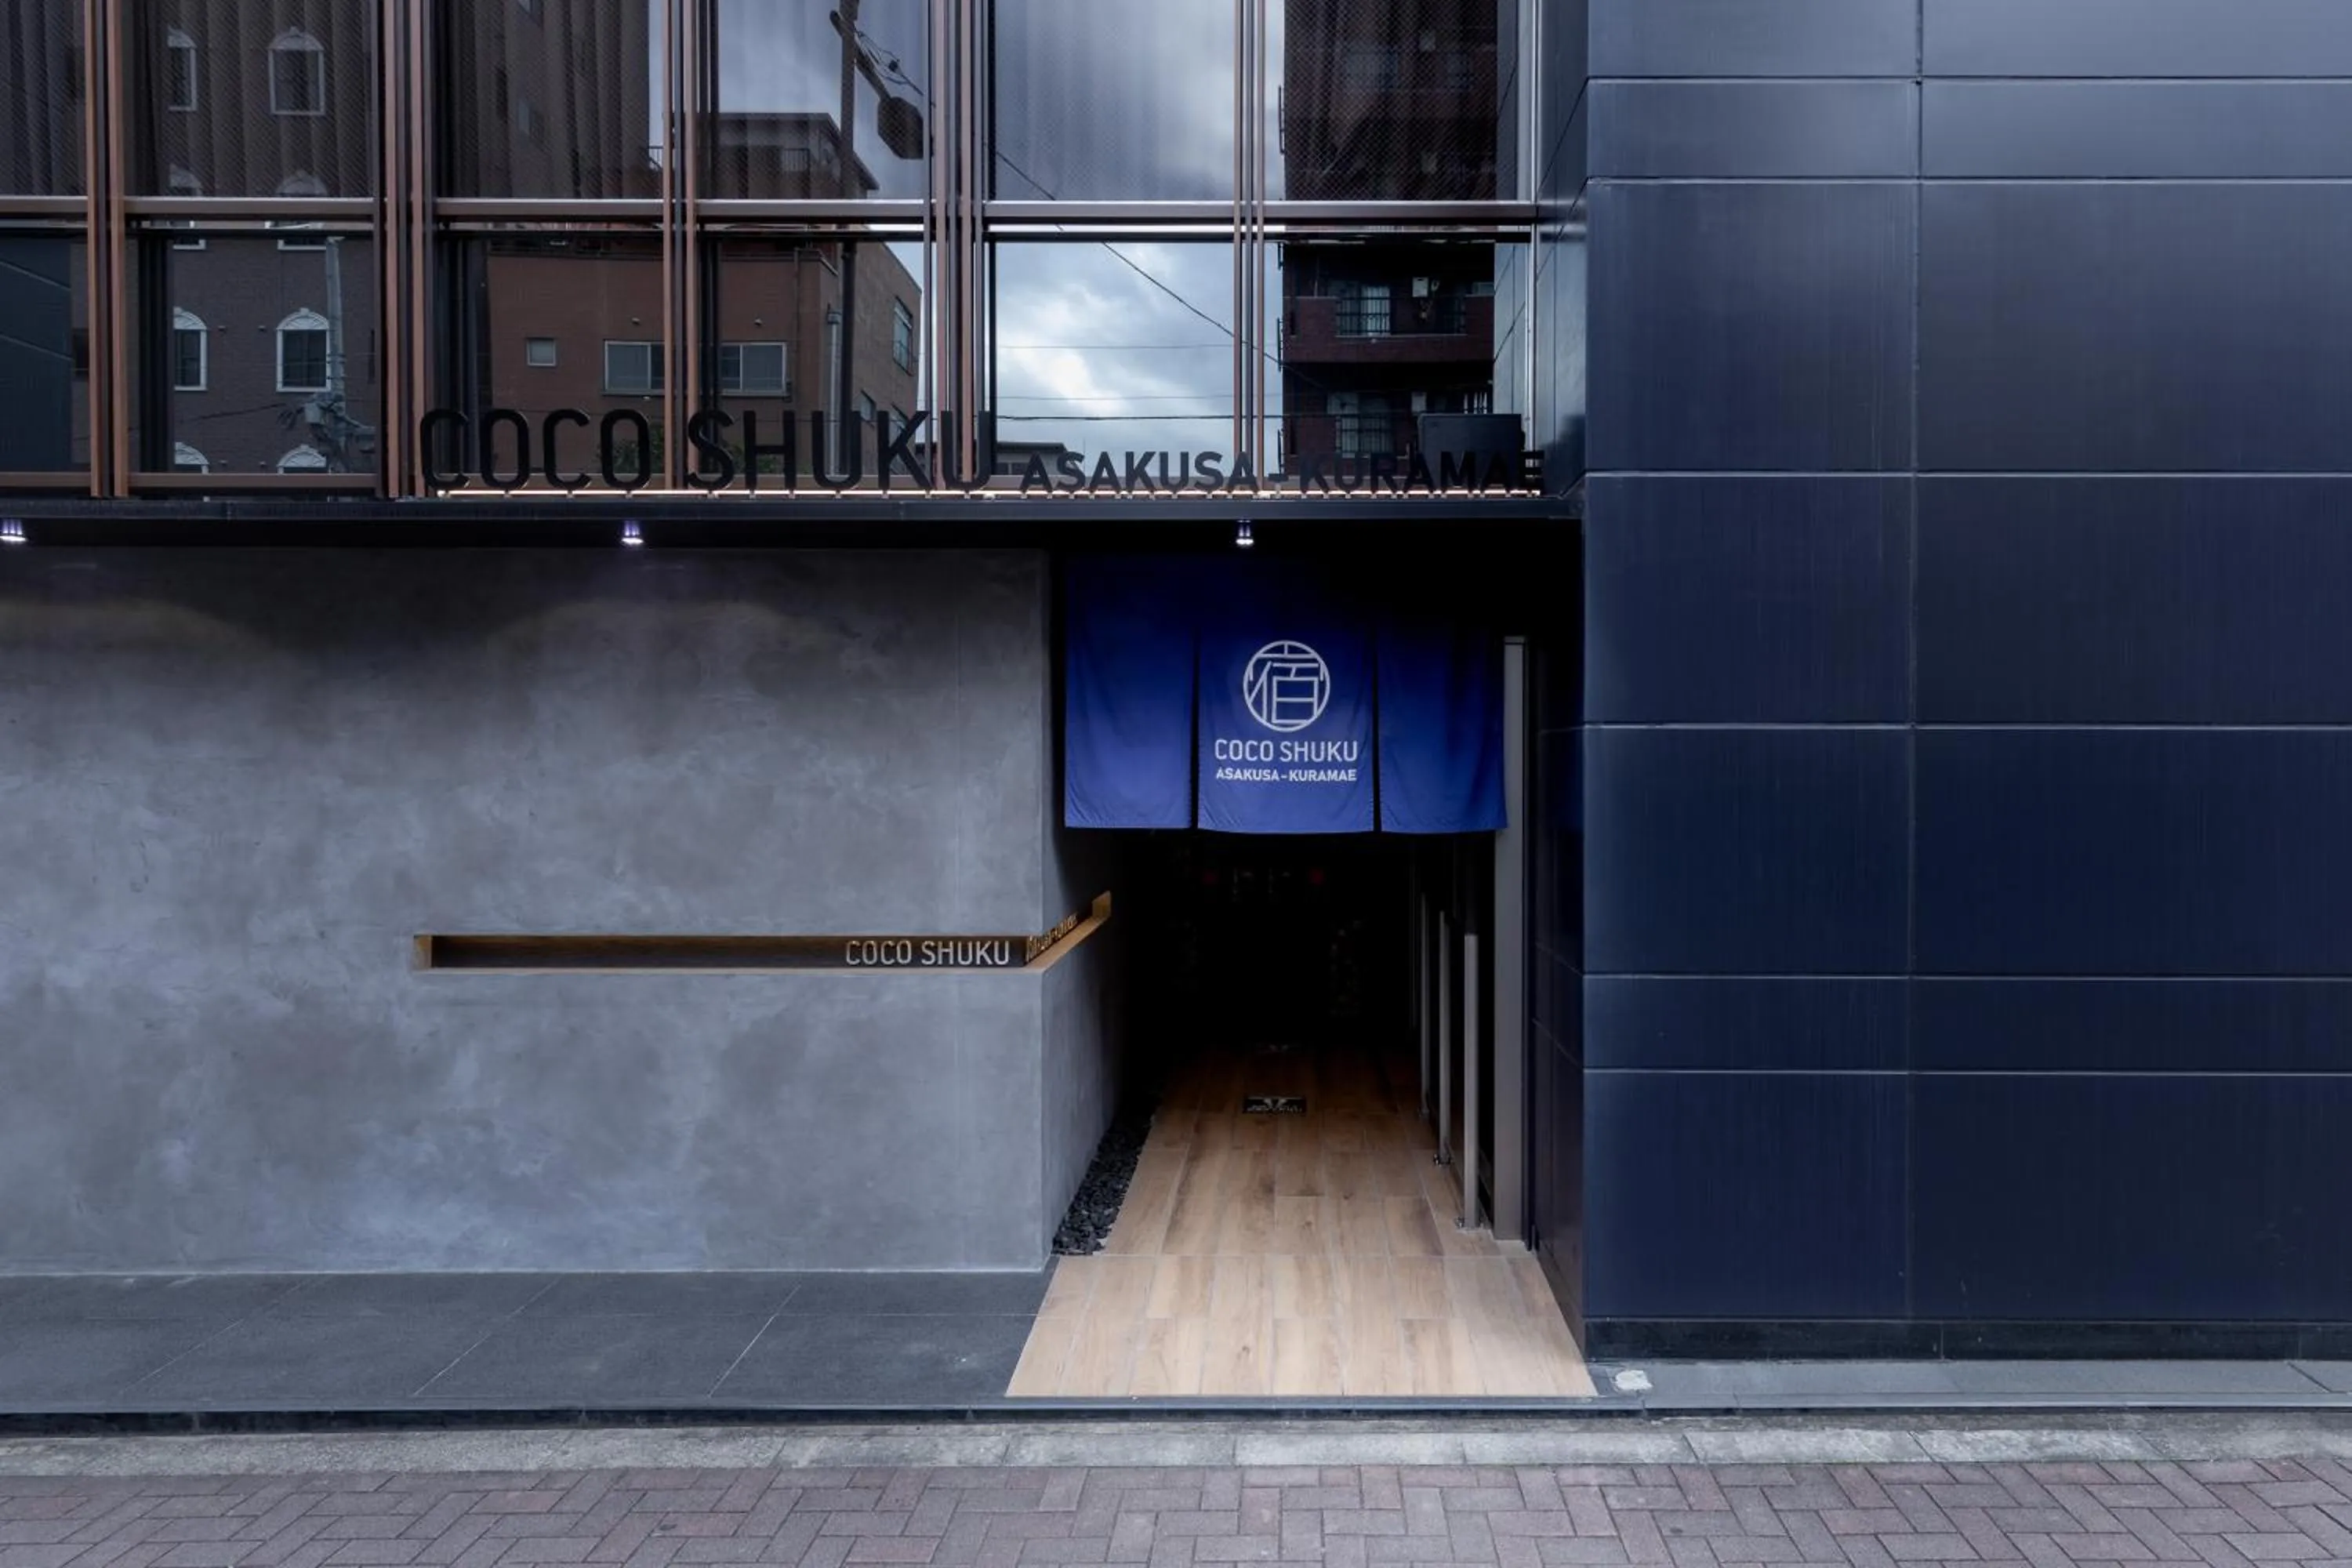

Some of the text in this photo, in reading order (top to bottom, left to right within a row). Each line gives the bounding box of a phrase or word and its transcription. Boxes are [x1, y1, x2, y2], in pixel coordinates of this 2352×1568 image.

[419, 408, 650, 492] COCO
[687, 409, 991, 492] SHUKU
[1215, 739, 1358, 762] COCO SHUKU
[1216, 767, 1357, 782] ASAKUSA-KURAMAE
[845, 939, 1011, 966] COCO SHUKU
